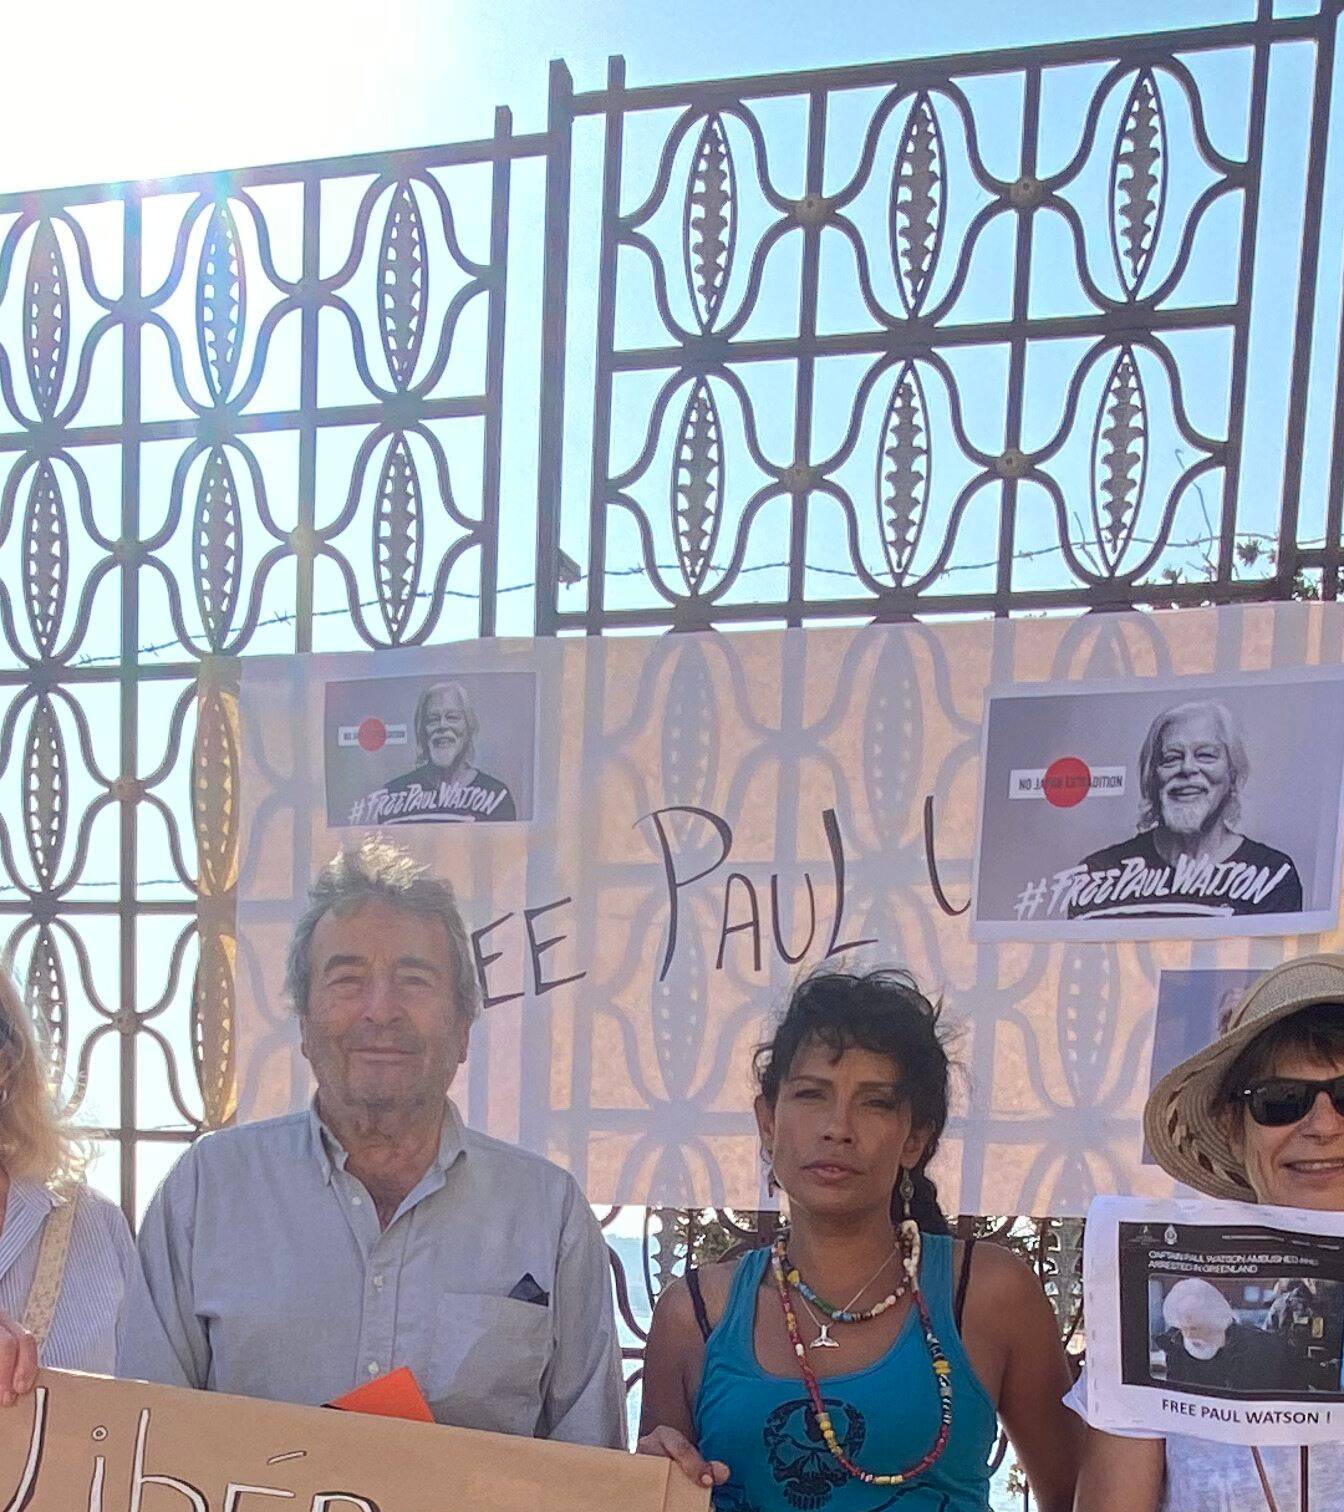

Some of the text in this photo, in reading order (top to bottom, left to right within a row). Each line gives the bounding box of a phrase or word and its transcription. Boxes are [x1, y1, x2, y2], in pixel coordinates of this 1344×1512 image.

[632, 805, 879, 982] PAUL
[1162, 1399, 1197, 1417] FREE
[1201, 1406, 1240, 1424] PAUL
[1245, 1410, 1319, 1425] WATSON
